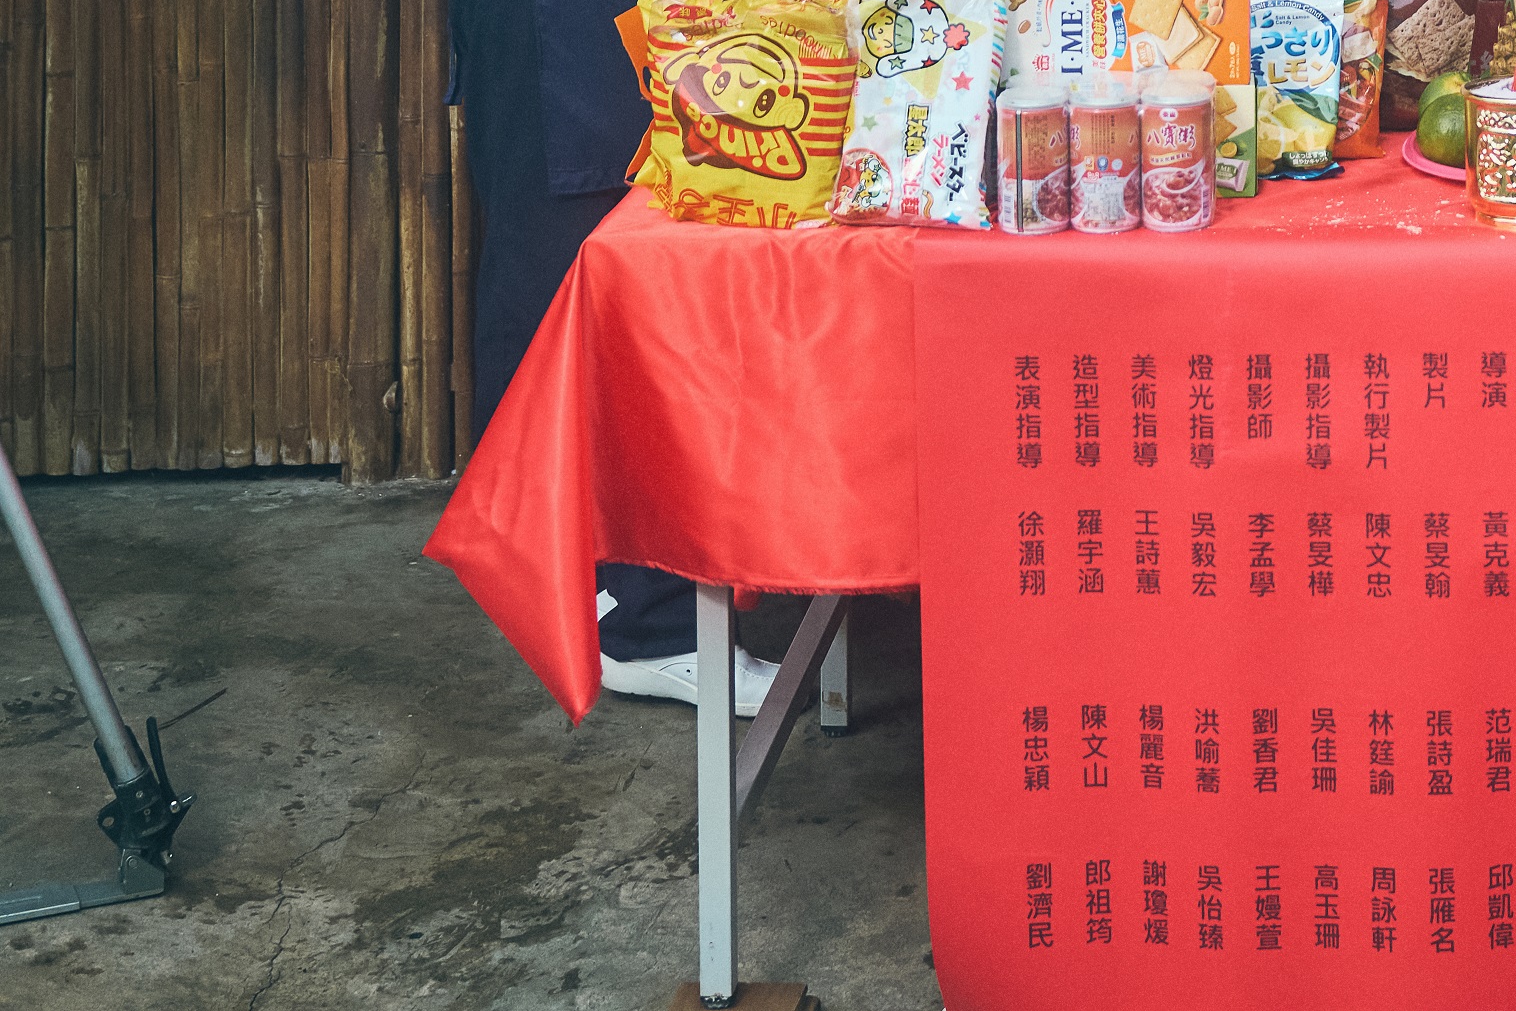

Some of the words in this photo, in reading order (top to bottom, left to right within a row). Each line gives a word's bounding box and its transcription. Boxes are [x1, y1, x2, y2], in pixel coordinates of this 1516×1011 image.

[1250, 26, 1332, 57] っさり
[1275, 0, 1302, 12] Lemon
[1303, 3, 1325, 22] Candy
[685, 100, 803, 175] Prince
[931, 133, 951, 188] ラーメン
[948, 122, 971, 202] ベビースター
[1146, 122, 1197, 150] 八寶粥
[1015, 354, 1042, 469] 表演指導
[1073, 354, 1100, 468] 造型指導
[1131, 354, 1157, 468] 美術指導
[1188, 354, 1215, 470] 燈光指導
[1246, 354, 1273, 439] 攝影師
[1305, 353, 1331, 470] 攝影指導
[1364, 353, 1390, 469] 執行製片
[1422, 352, 1448, 409] 製片
[1481, 351, 1507, 408] 導演
[1018, 511, 1046, 596] 徐灝翔
[1077, 509, 1104, 594] 羅宇涵
[1135, 509, 1161, 595] 王詩蕙
[1192, 512, 1217, 597] 吳毅宏
[1249, 512, 1275, 598] 李孟學
[1307, 511, 1334, 596] 蔡旻樺
[1365, 512, 1392, 598] 陳文忠
[1424, 512, 1451, 599] 蔡旻翰
[1484, 511, 1510, 597] 黃克義
[1022, 705, 1050, 791] 楊忠穎
[1081, 703, 1108, 788] 陳文山
[1139, 704, 1164, 789] 楊麗音
[1252, 708, 1278, 793] 劉香君
[1311, 707, 1337, 793] 吳佳珊
[1426, 710, 1453, 796] 張詩盈
[1485, 707, 1512, 793] 范瑞君
[1026, 862, 1054, 949] 劉濟民
[1085, 859, 1112, 944] 郎祖筠
[1197, 865, 1224, 950] 吳怡臻
[1255, 865, 1282, 951] 王嫚萱
[1314, 864, 1340, 949] 高玉珊
[1371, 866, 1397, 952] 周詠軒
[1429, 867, 1455, 954] 張雁名
[1488, 863, 1514, 950] 邱凱偉
